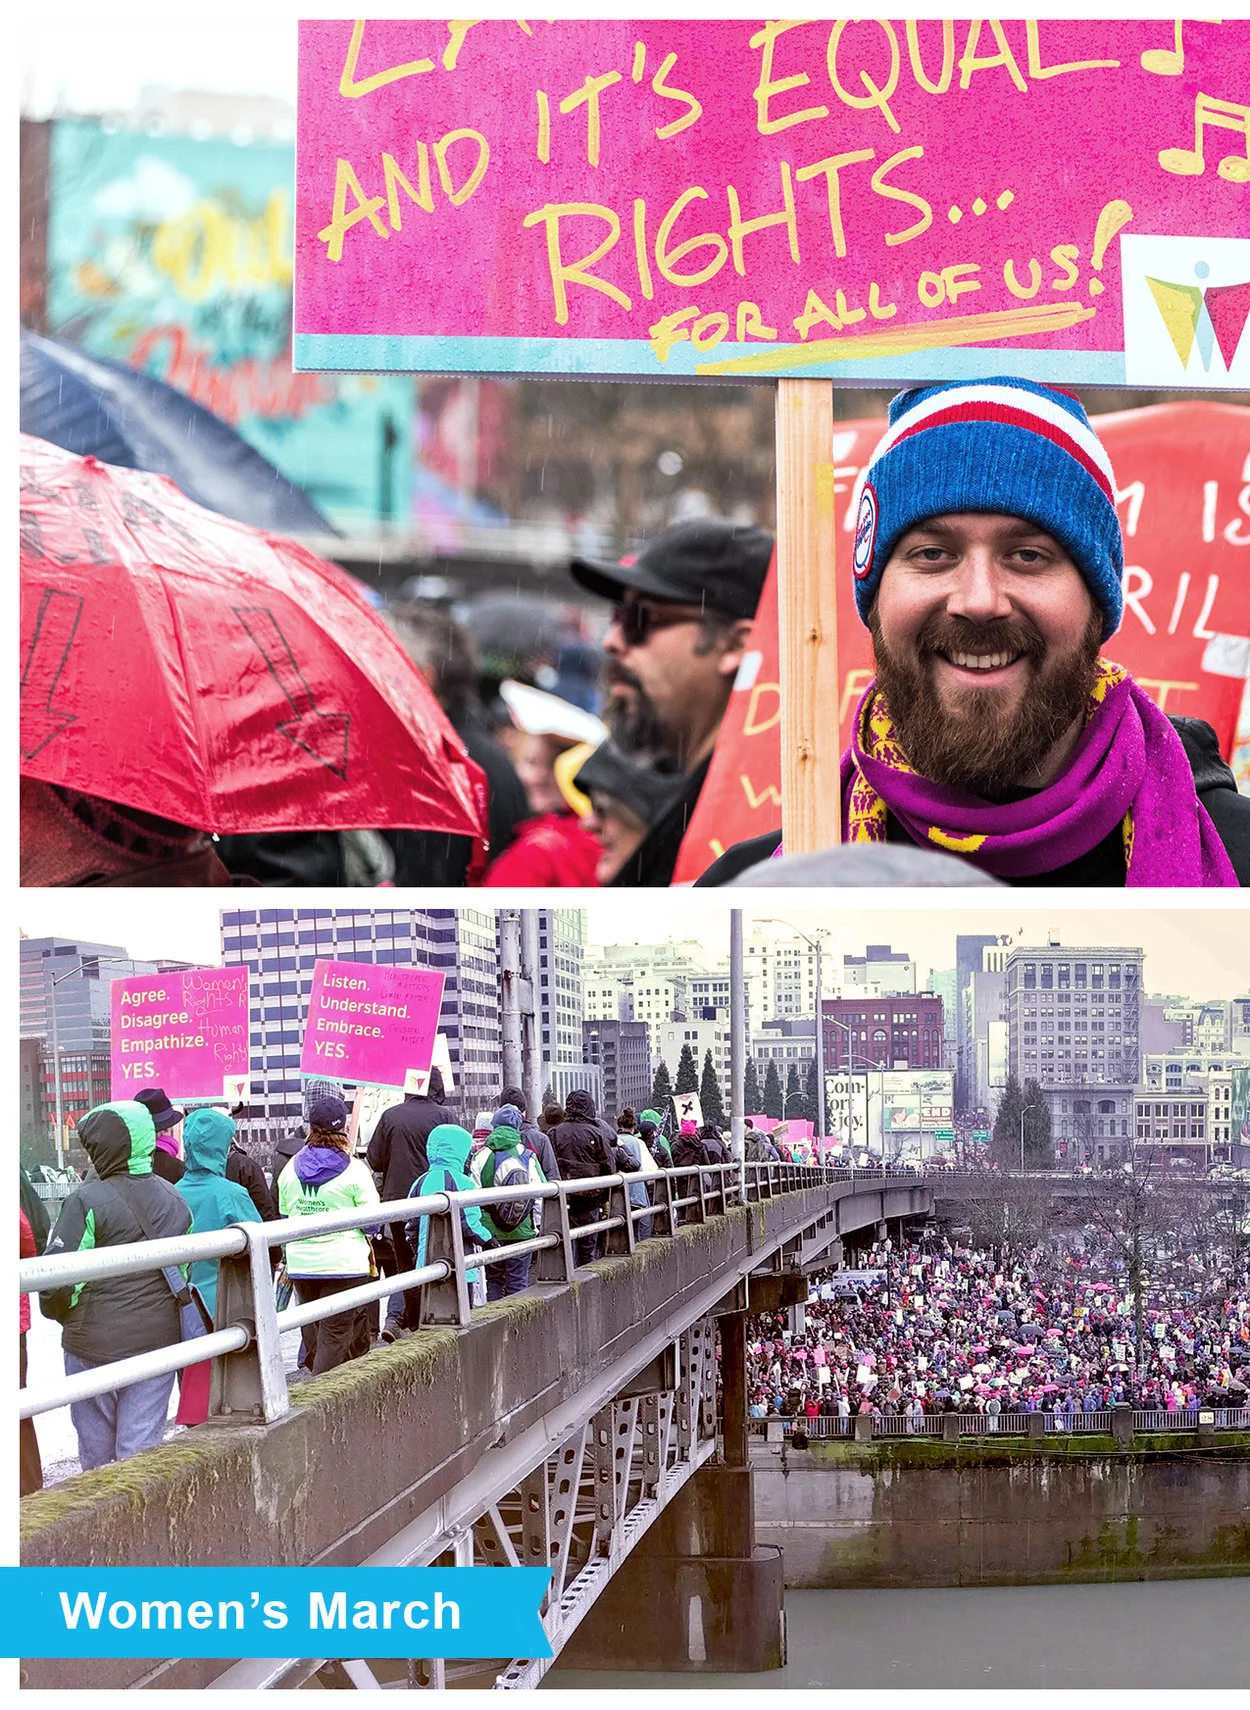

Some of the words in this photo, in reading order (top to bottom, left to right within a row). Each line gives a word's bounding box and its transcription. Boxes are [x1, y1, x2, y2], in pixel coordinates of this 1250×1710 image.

[536, 41, 702, 168] IT'S
[750, 20, 1120, 134] EQUAL
[317, 129, 490, 262] AND
[523, 146, 1014, 326] RIGHTS...
[649, 302, 777, 362] FOR
[795, 283, 896, 340] ALL
[918, 264, 982, 308] OF
[323, 973, 371, 991] Listen.
[121, 988, 170, 1007] Agree.
[320, 995, 411, 1019] Understand.
[121, 1011, 193, 1029] Disagree.
[316, 1017, 385, 1039] Embrace.
[121, 1033, 209, 1054] Empathize.
[314, 1040, 350, 1059] YES.
[121, 1061, 160, 1080] YES.
[824, 1079, 865, 1094] Com-
[838, 1112, 863, 1132] joy.
